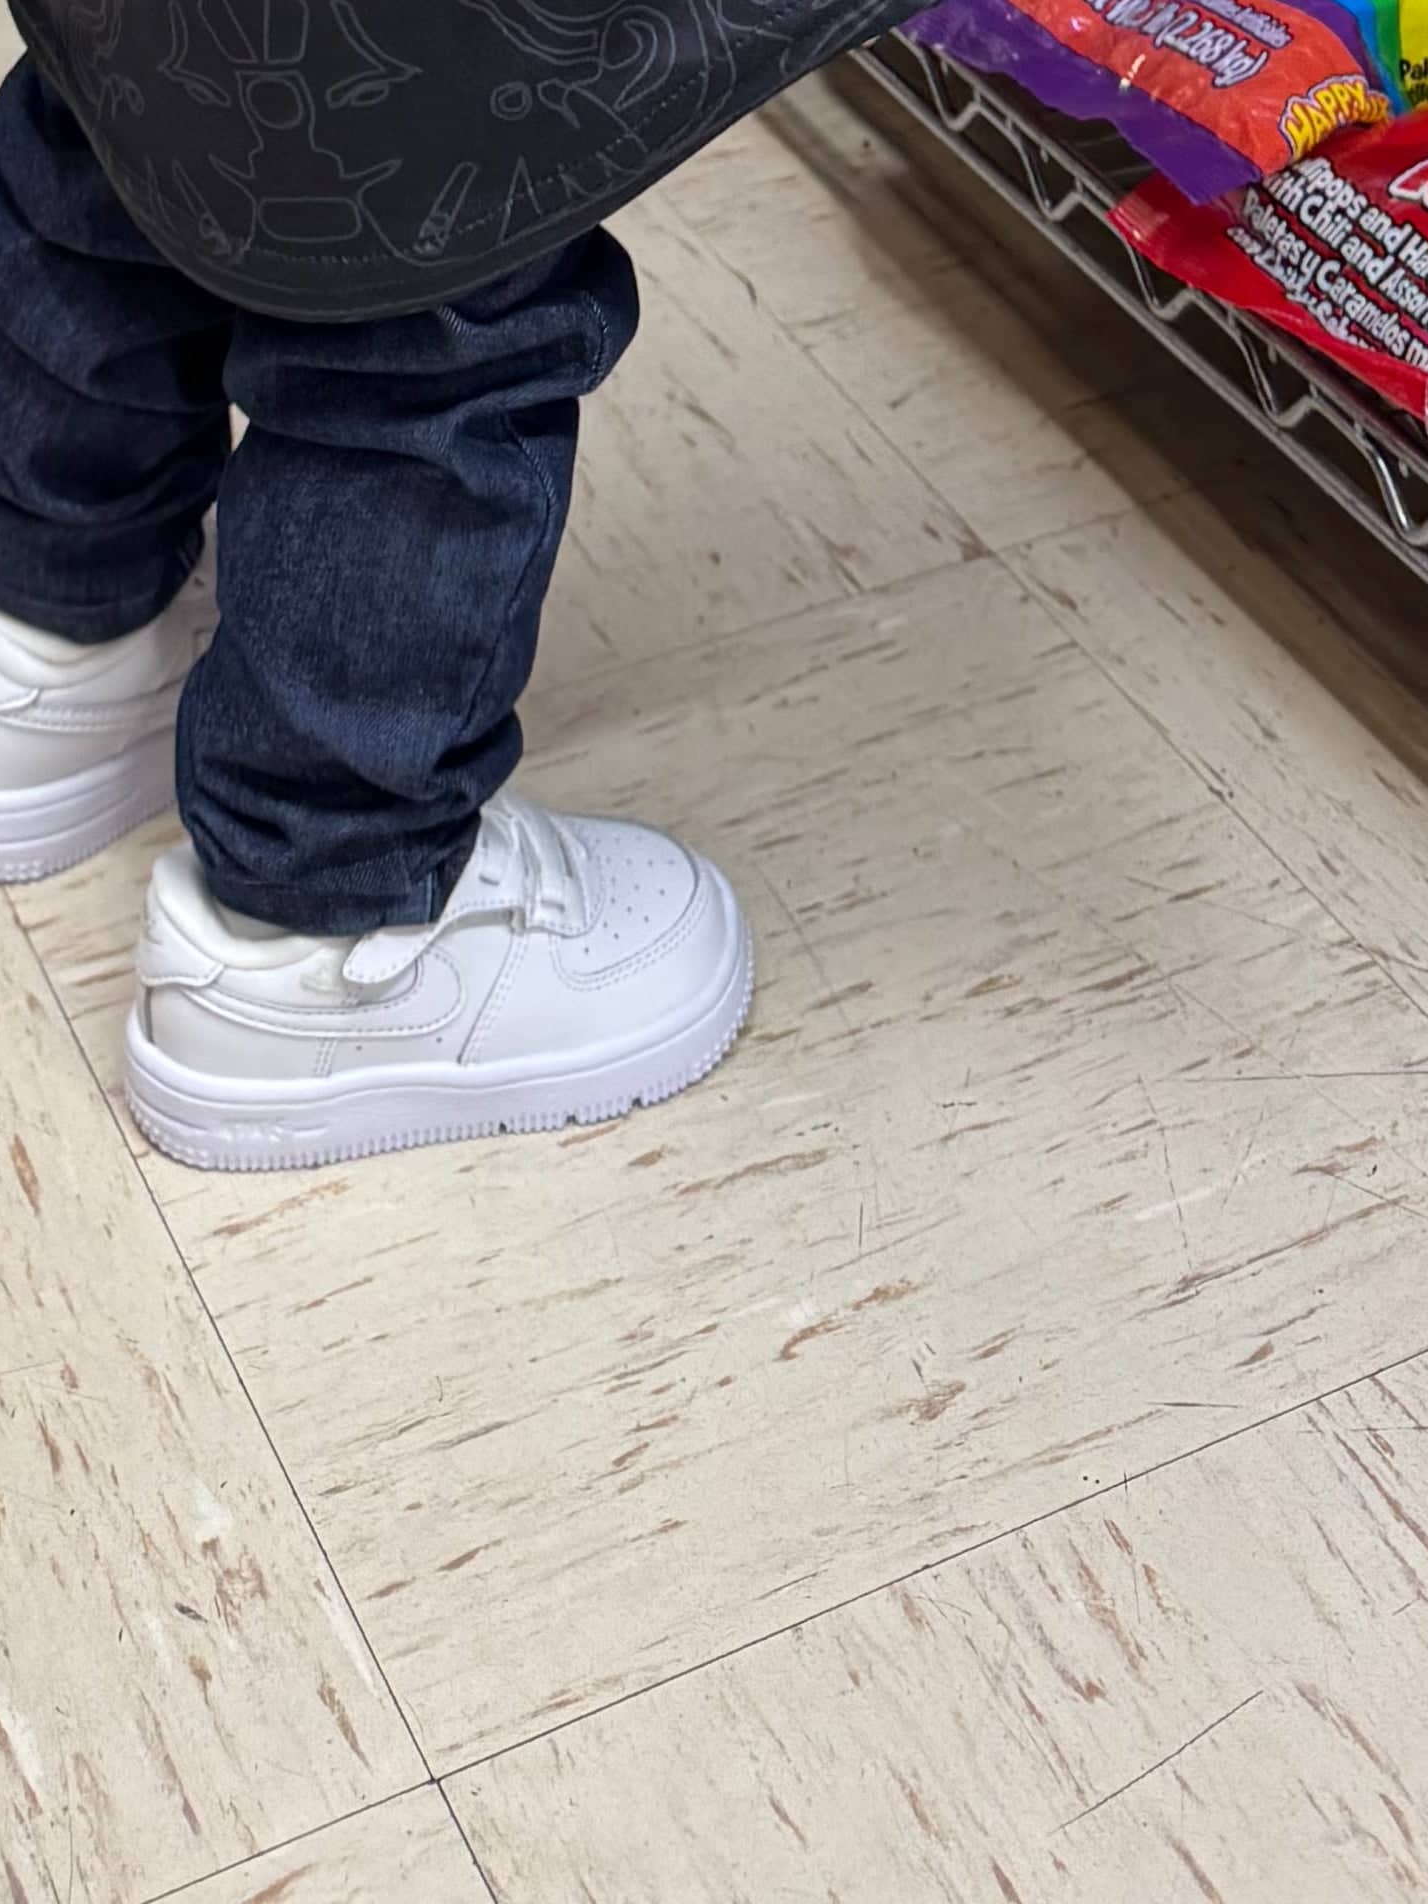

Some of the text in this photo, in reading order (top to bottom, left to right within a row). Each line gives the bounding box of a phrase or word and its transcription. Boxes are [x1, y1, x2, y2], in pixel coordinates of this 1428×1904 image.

[1280, 75, 1369, 154] HAPPY
[1299, 196, 1353, 250] Chili
[1340, 234, 1393, 286] and
[1359, 208, 1413, 254] and
[1300, 250, 1321, 287] y
[1315, 257, 1411, 358] Caramelos
